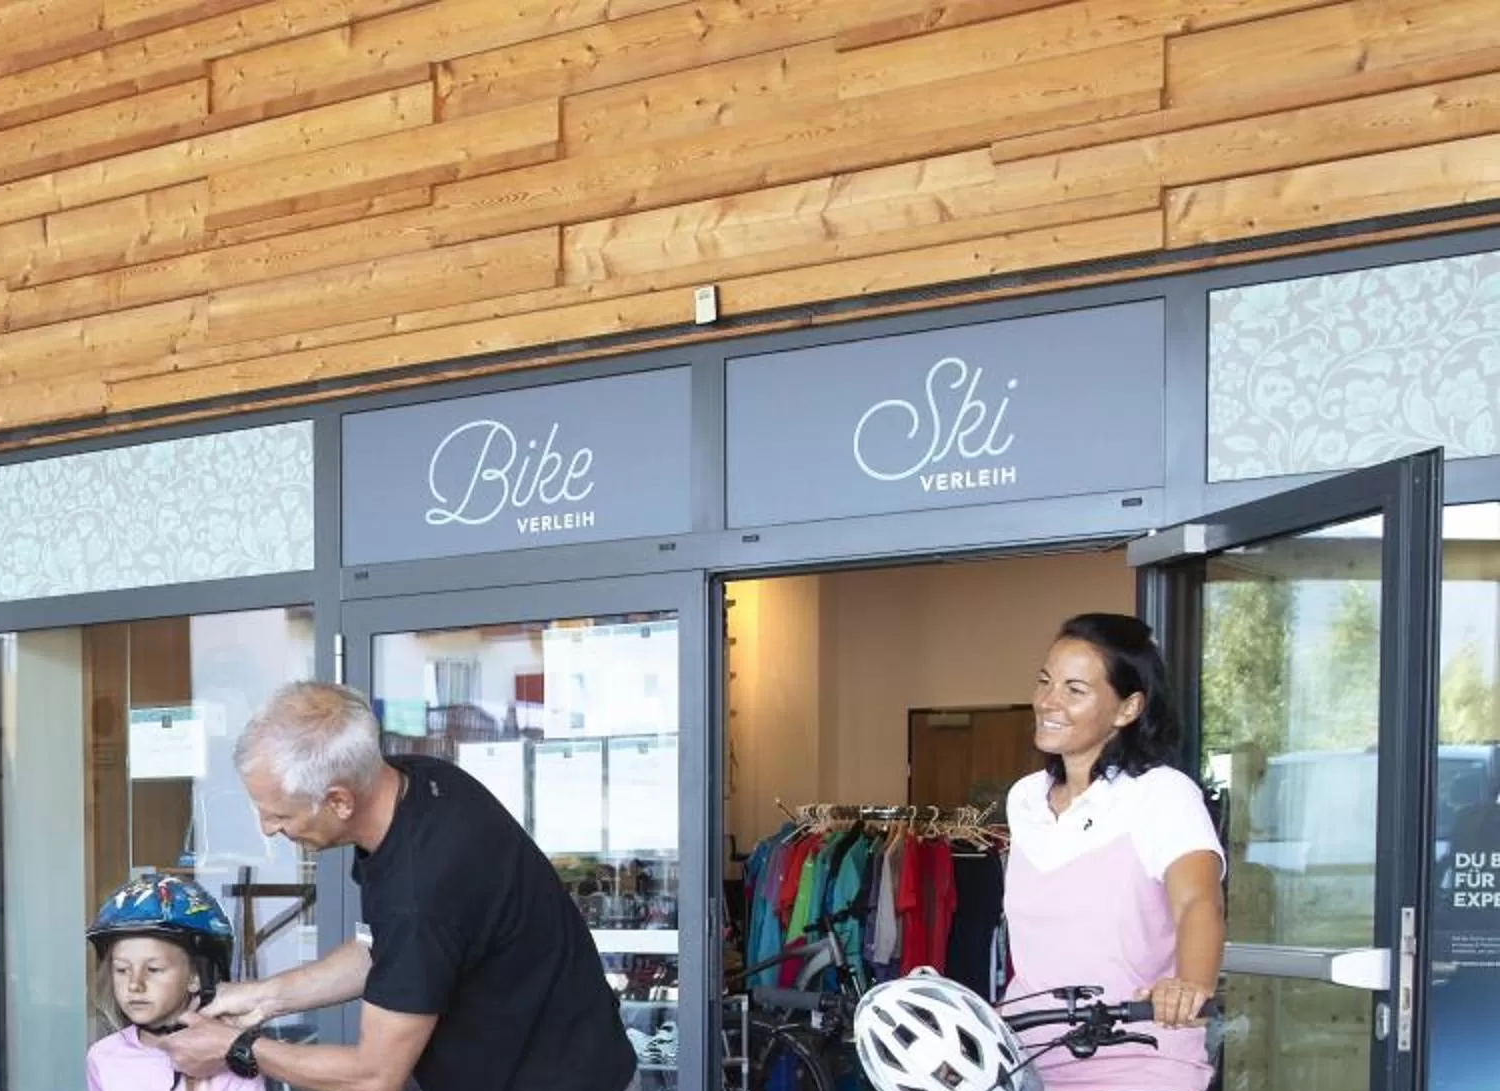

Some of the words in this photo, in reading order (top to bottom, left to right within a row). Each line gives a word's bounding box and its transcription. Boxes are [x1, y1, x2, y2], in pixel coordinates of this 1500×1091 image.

[854, 357, 1018, 480] Ski
[425, 419, 595, 525] Bike
[919, 465, 1017, 492] VERLEIH
[516, 512, 595, 534] VERLEIH
[1455, 852, 1485, 868] DU
[1454, 868, 1495, 888] FÜR
